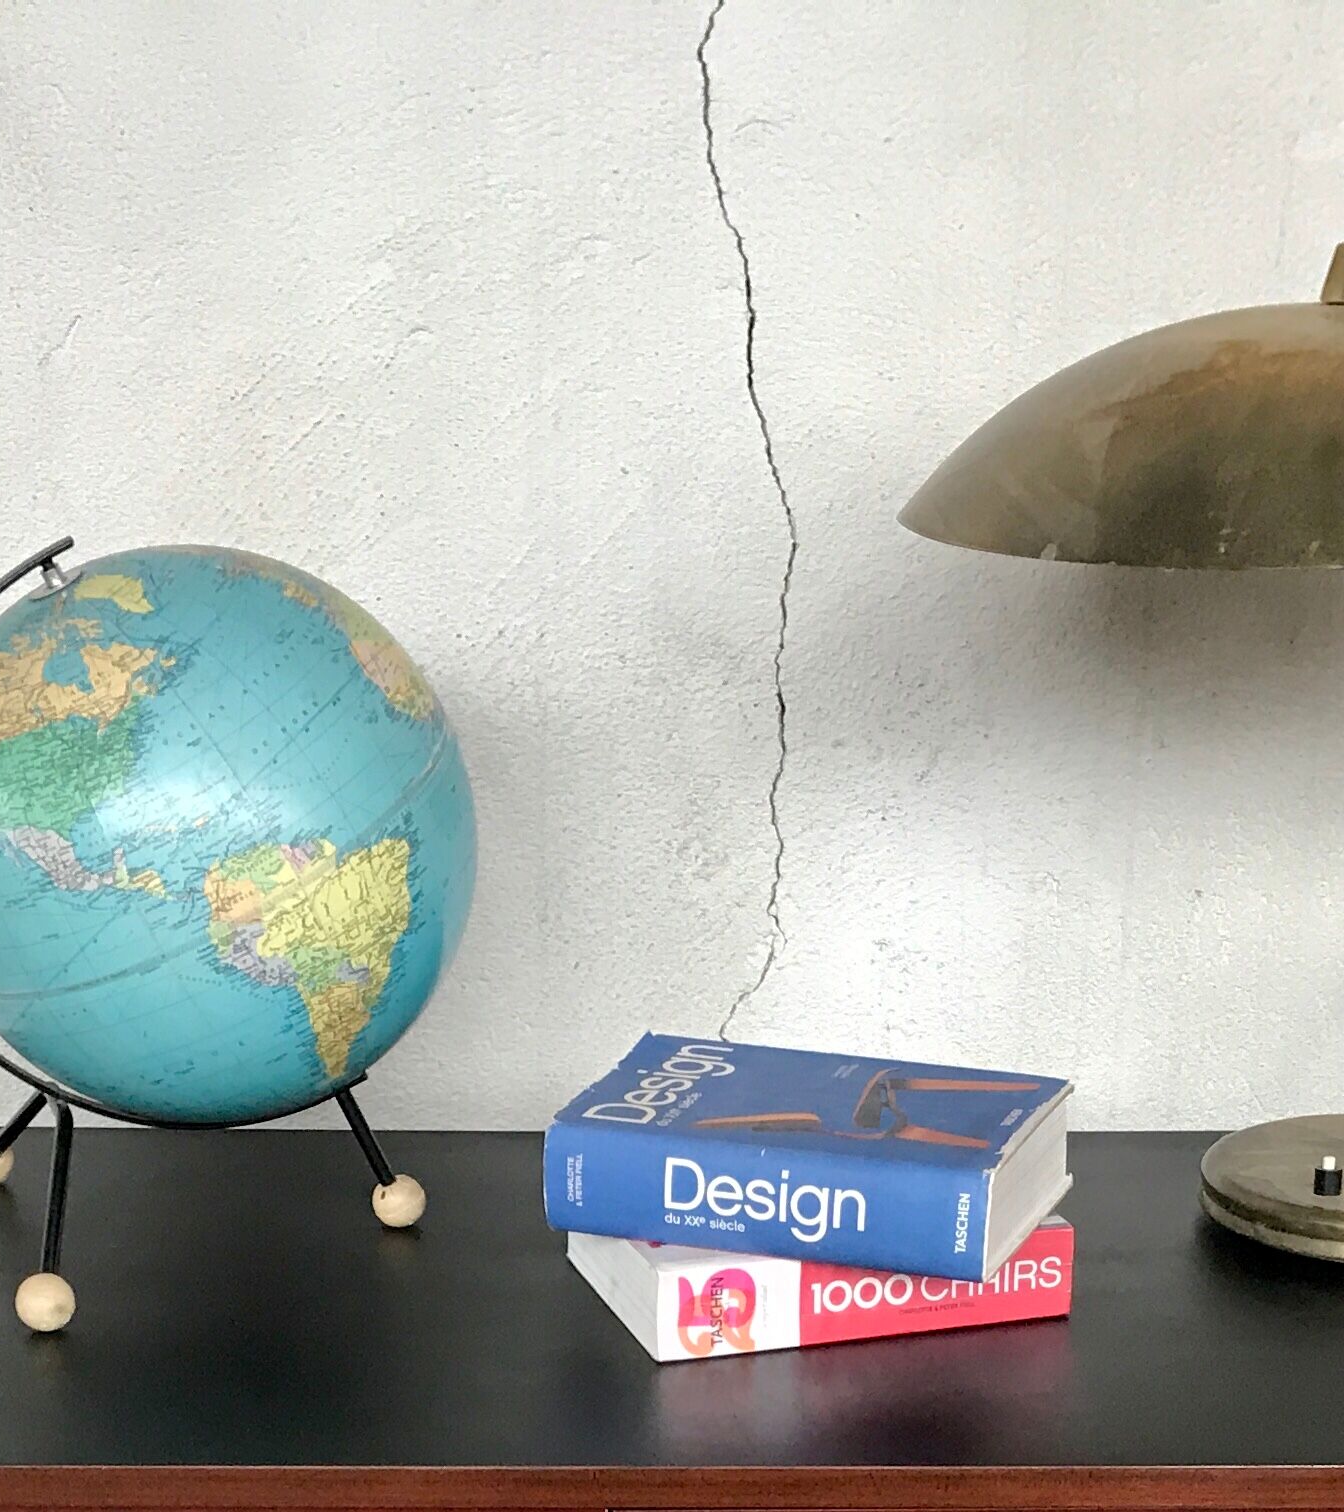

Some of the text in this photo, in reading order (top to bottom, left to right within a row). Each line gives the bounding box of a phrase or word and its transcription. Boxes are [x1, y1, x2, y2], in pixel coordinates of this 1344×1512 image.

[581, 1044, 736, 1124] Design
[664, 1156, 867, 1243] Design
[665, 1213, 681, 1225] du
[709, 1219, 746, 1233] siècle
[954, 1192, 971, 1254] TASCHEN
[710, 1277, 725, 1348] TASCHEN
[810, 1273, 914, 1315] 1000
